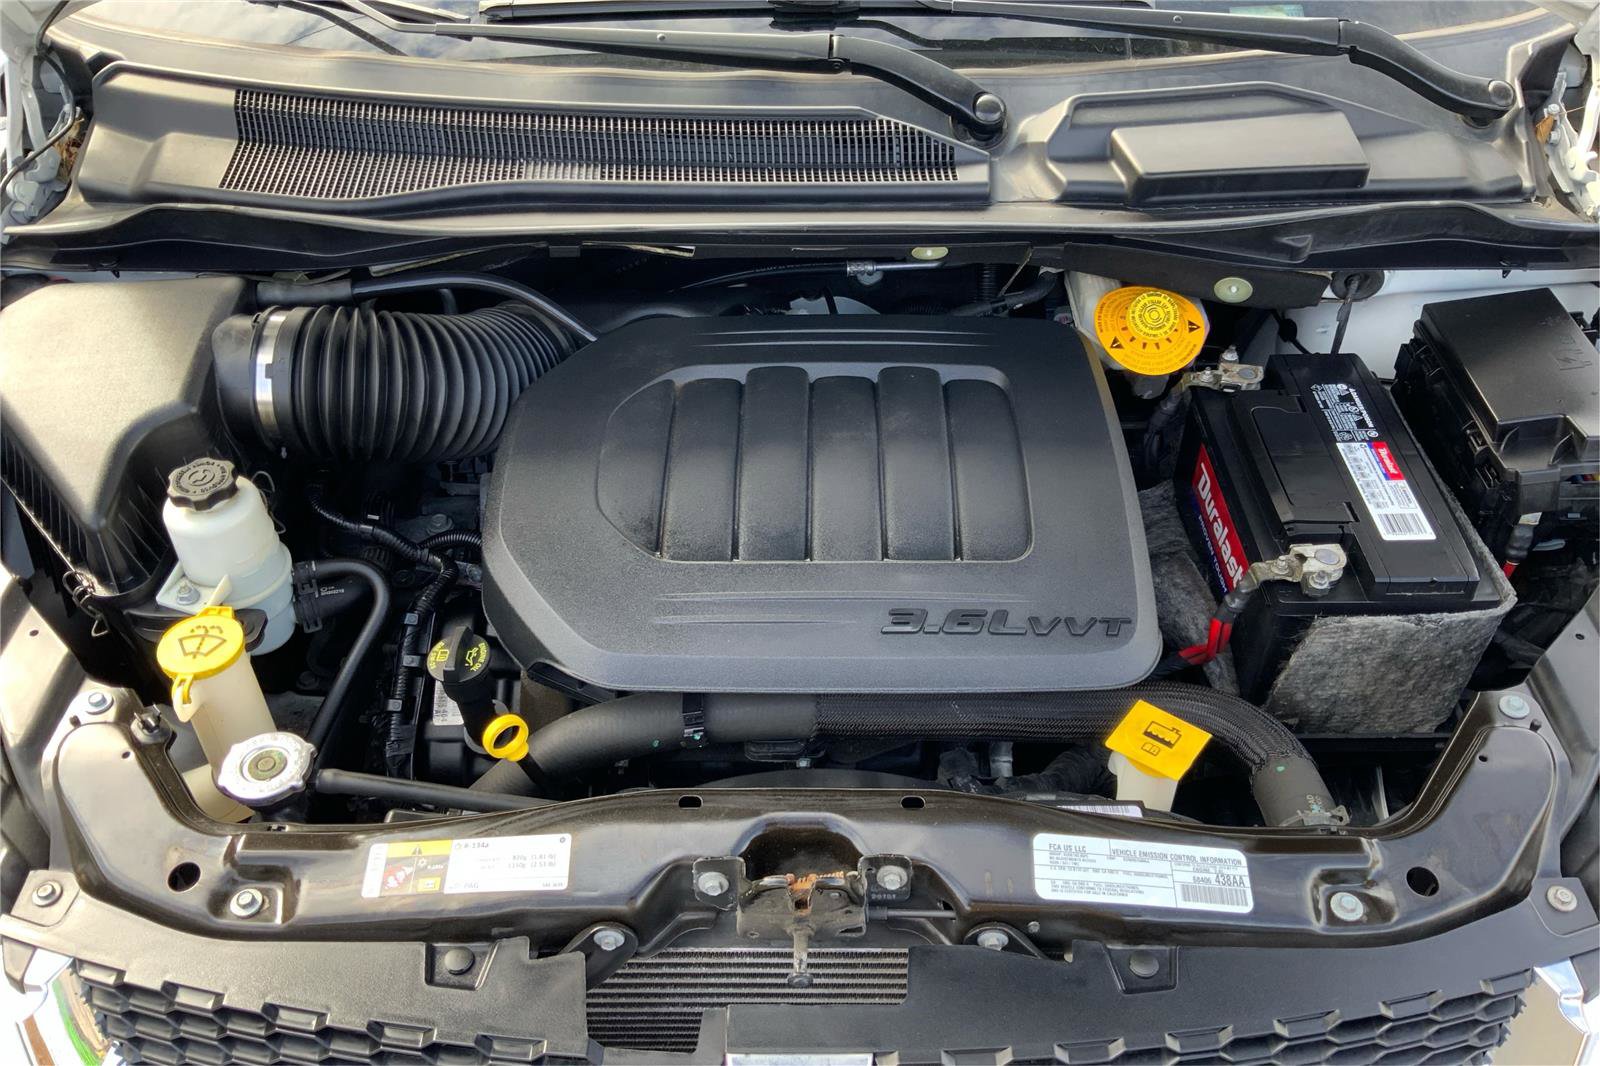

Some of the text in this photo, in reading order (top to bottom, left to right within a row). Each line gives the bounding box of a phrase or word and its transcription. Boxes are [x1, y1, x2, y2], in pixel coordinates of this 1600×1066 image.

[1198, 462, 1244, 589] Duralast
[880, 608, 1132, 637] 3.6L VVT
[1048, 843, 1087, 853] FCA US LLC
[1111, 848, 1137, 857] VEHICLE
[1138, 850, 1168, 860] EMISSION
[1169, 853, 1198, 863] CONTROL
[1199, 855, 1242, 866] INFORMATION
[1215, 874, 1246, 888] 438AA
